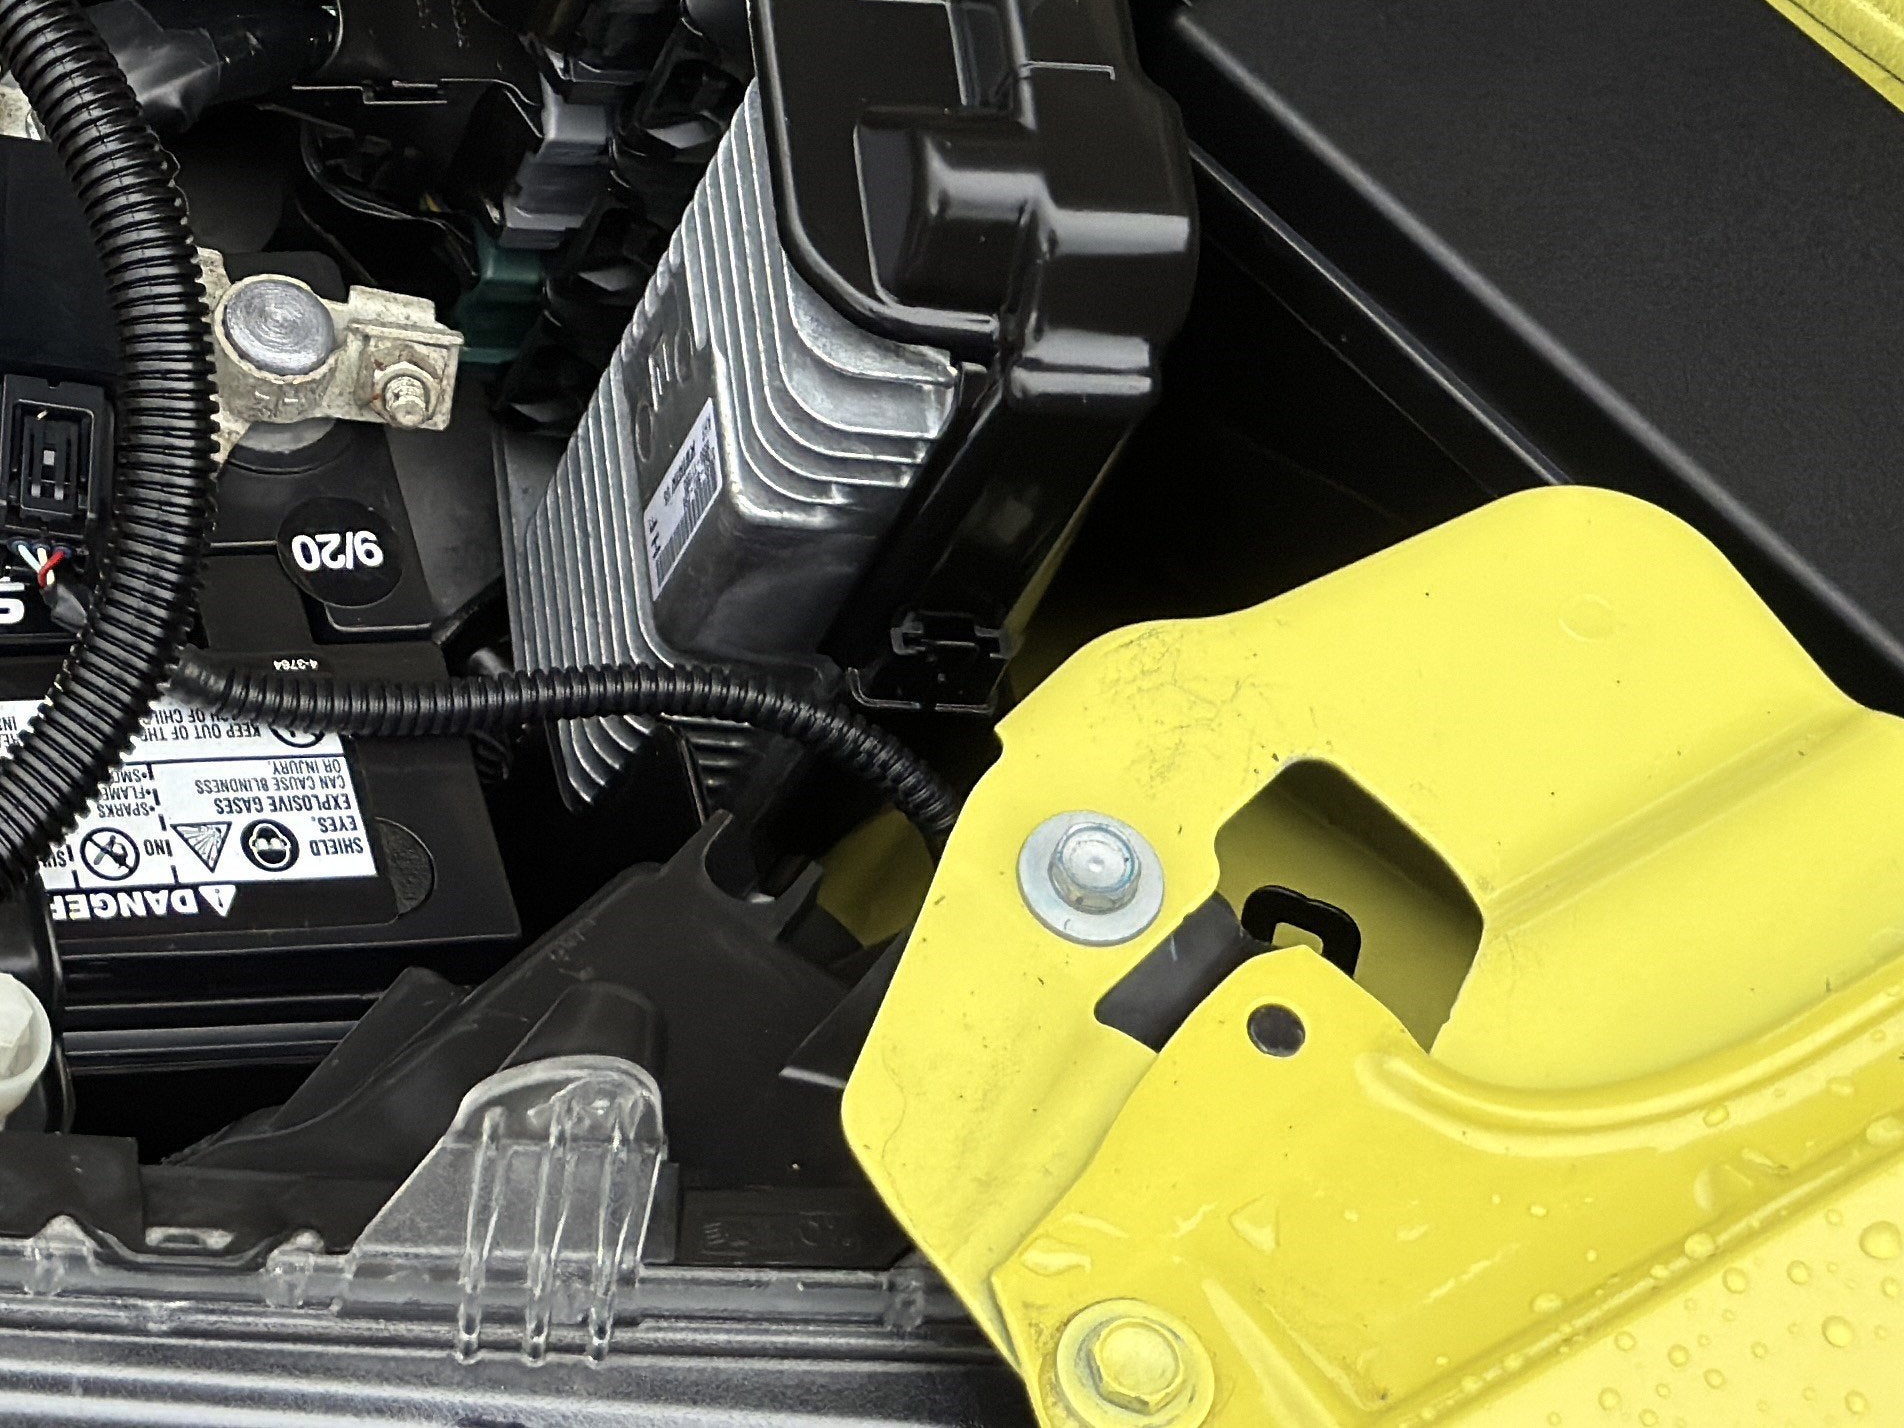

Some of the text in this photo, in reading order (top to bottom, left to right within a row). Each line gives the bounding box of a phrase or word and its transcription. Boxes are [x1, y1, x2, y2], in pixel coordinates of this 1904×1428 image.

[291, 530, 383, 570] 9/20
[171, 726, 188, 740] OF
[194, 724, 221, 739] OUT
[226, 723, 261, 738] KEEP
[268, 758, 341, 775] OR INJURY.
[195, 774, 346, 794] CAN CAUSE BLINDNESS
[213, 793, 352, 815] EXPLOSIVE GASES
[311, 815, 357, 833] EYES.
[143, 839, 166, 856] NO
[309, 837, 364, 856] SHIELD
